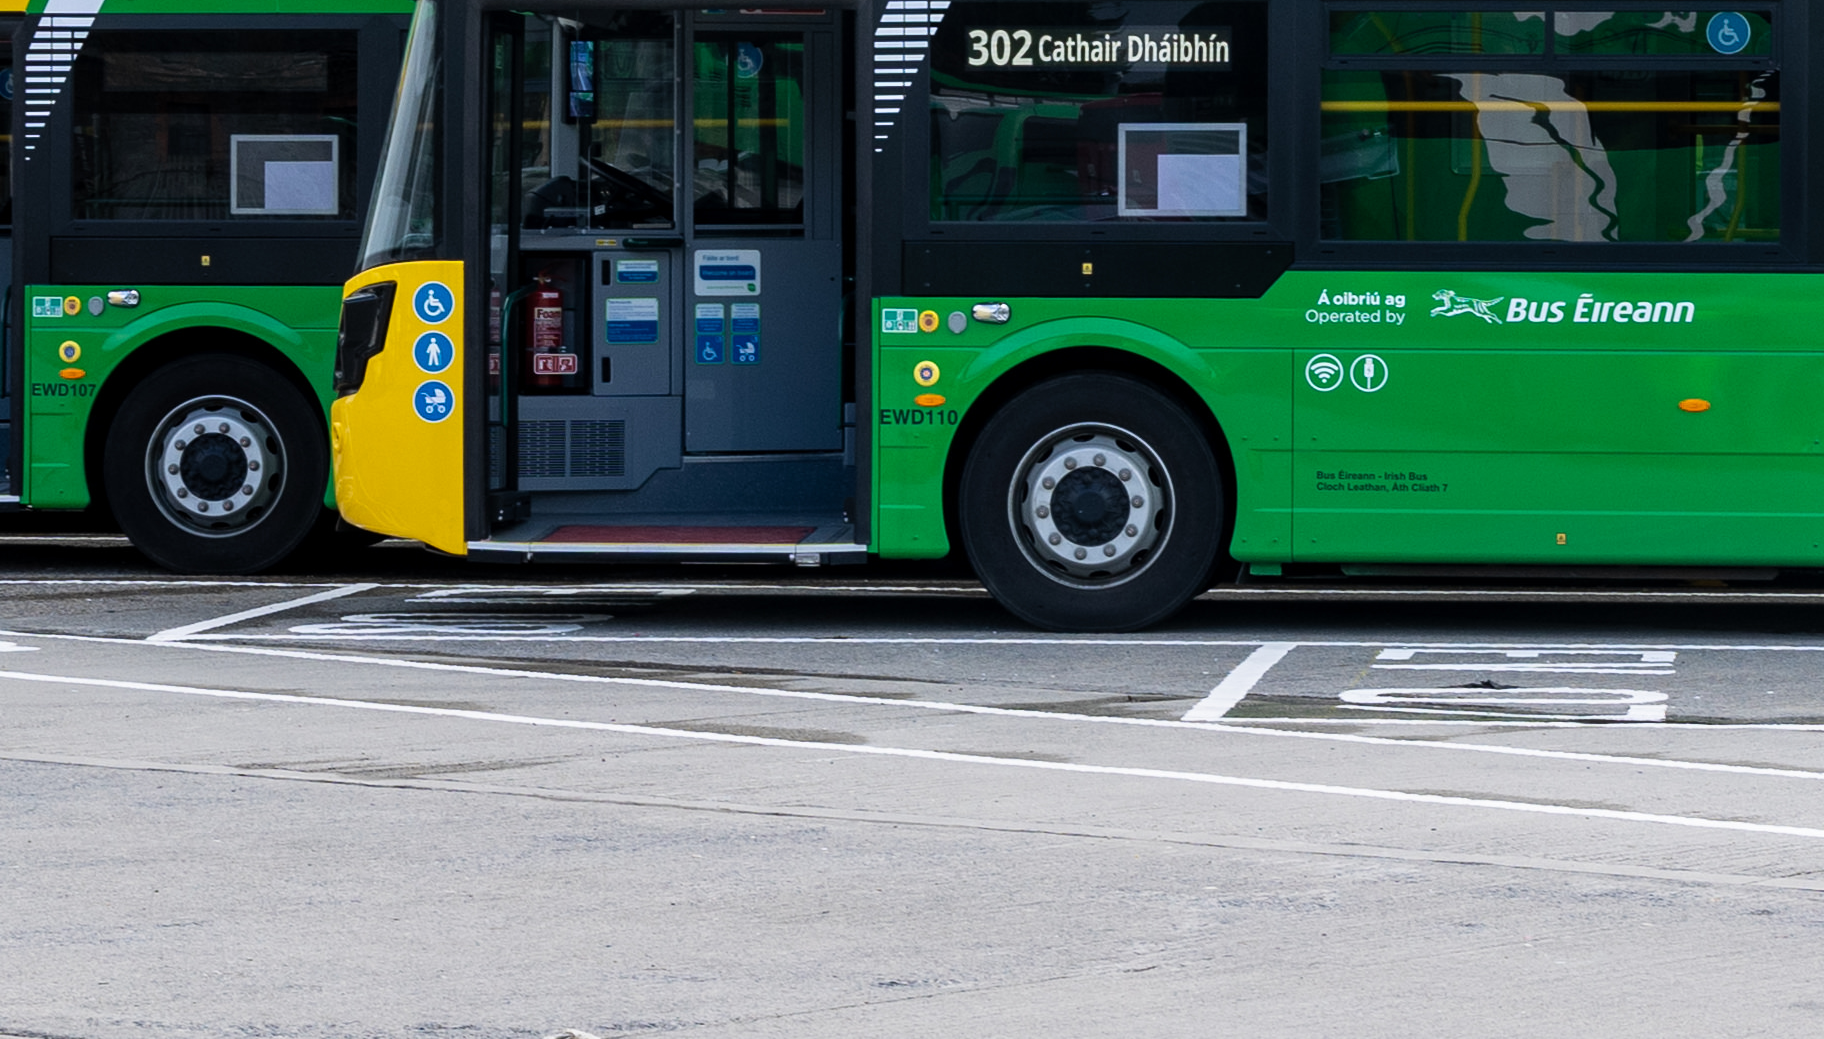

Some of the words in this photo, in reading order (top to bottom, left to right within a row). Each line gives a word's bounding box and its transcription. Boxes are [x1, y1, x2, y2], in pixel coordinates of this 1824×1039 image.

[969, 30, 1032, 65] 302
[1039, 34, 1121, 62] Cathair
[1128, 34, 1228, 62] Dháibhín
[1318, 288, 1330, 305] Á
[1333, 292, 1380, 305] oibriú
[1385, 295, 1405, 307] ag
[1305, 309, 1382, 325] Operated
[1387, 309, 1406, 325] by
[1506, 298, 1566, 322] Bus
[31, 383, 97, 398] EWD107
[880, 409, 959, 425] EWD110
[1316, 471, 1335, 480] Bus
[1338, 470, 1375, 480] Éireann
[1384, 472, 1406, 481] Irish
[1409, 472, 1428, 481] Bus
[1442, 484, 1448, 492] 7
[1335, 687, 1670, 721] 07
